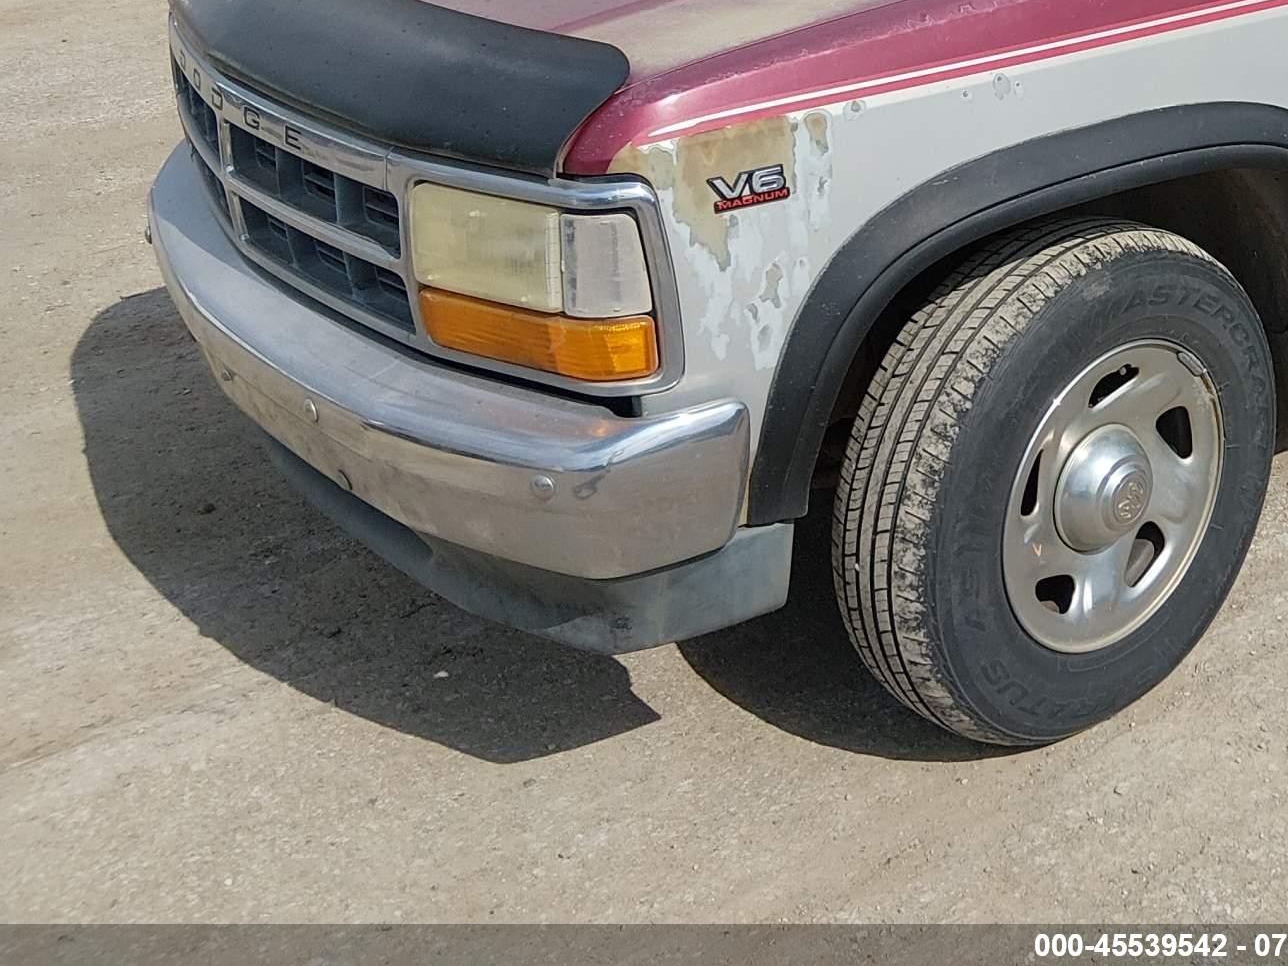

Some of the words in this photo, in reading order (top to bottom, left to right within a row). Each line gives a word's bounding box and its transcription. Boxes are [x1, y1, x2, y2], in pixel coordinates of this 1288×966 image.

[180, 49, 304, 150] DODGE
[707, 164, 786, 199] V6
[718, 188, 788, 210] MAGNUM
